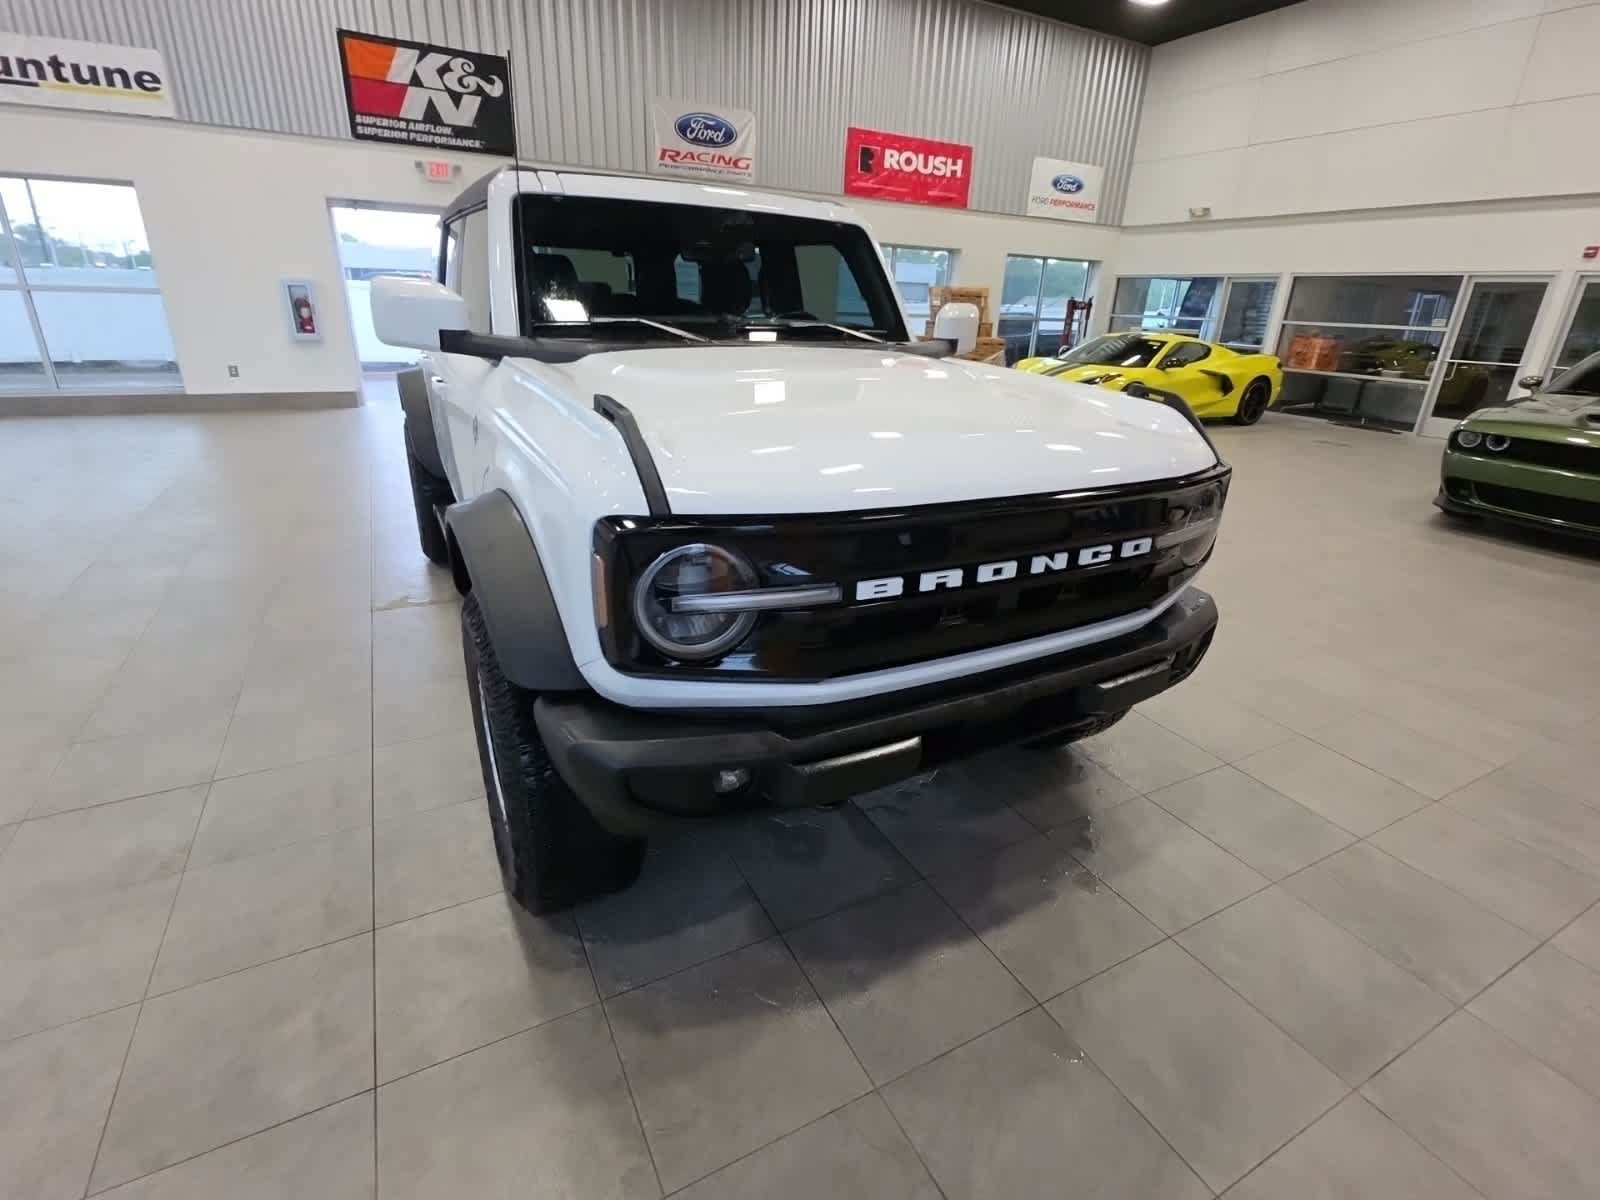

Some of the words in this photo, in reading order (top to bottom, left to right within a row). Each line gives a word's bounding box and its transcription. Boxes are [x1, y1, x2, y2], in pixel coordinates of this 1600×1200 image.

[355, 114, 407, 130] SUPERIOR
[356, 125, 408, 140] SUPERIOR
[686, 117, 726, 143] Ford
[659, 148, 752, 170] RACING
[884, 148, 963, 177] ROUSH
[1056, 176, 1078, 192] Ford
[856, 537, 1153, 600] BRONCO
